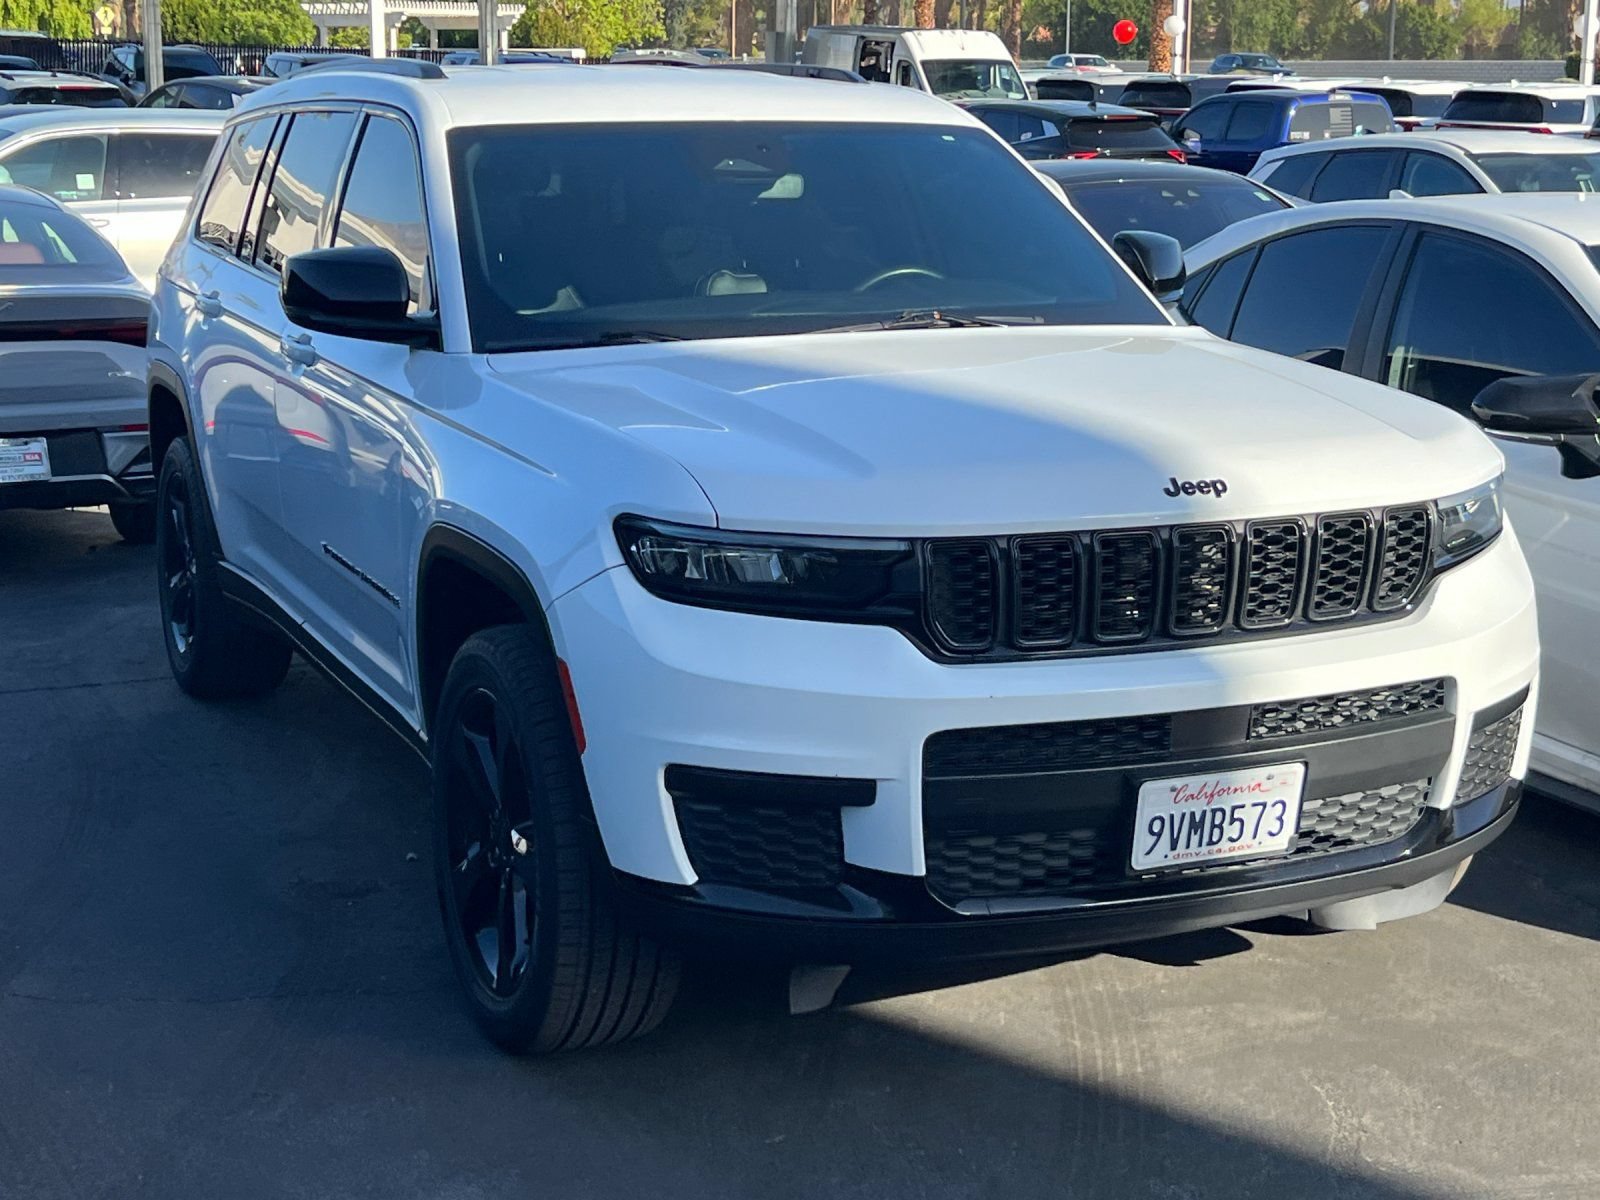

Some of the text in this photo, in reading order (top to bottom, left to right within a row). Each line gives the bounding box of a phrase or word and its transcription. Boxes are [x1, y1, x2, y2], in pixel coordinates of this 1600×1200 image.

[1163, 477, 1228, 498] Jeep
[1173, 780, 1271, 805] California
[1144, 799, 1287, 856] 9VMB573
[1172, 842, 1254, 860] dmv.ca.gov
